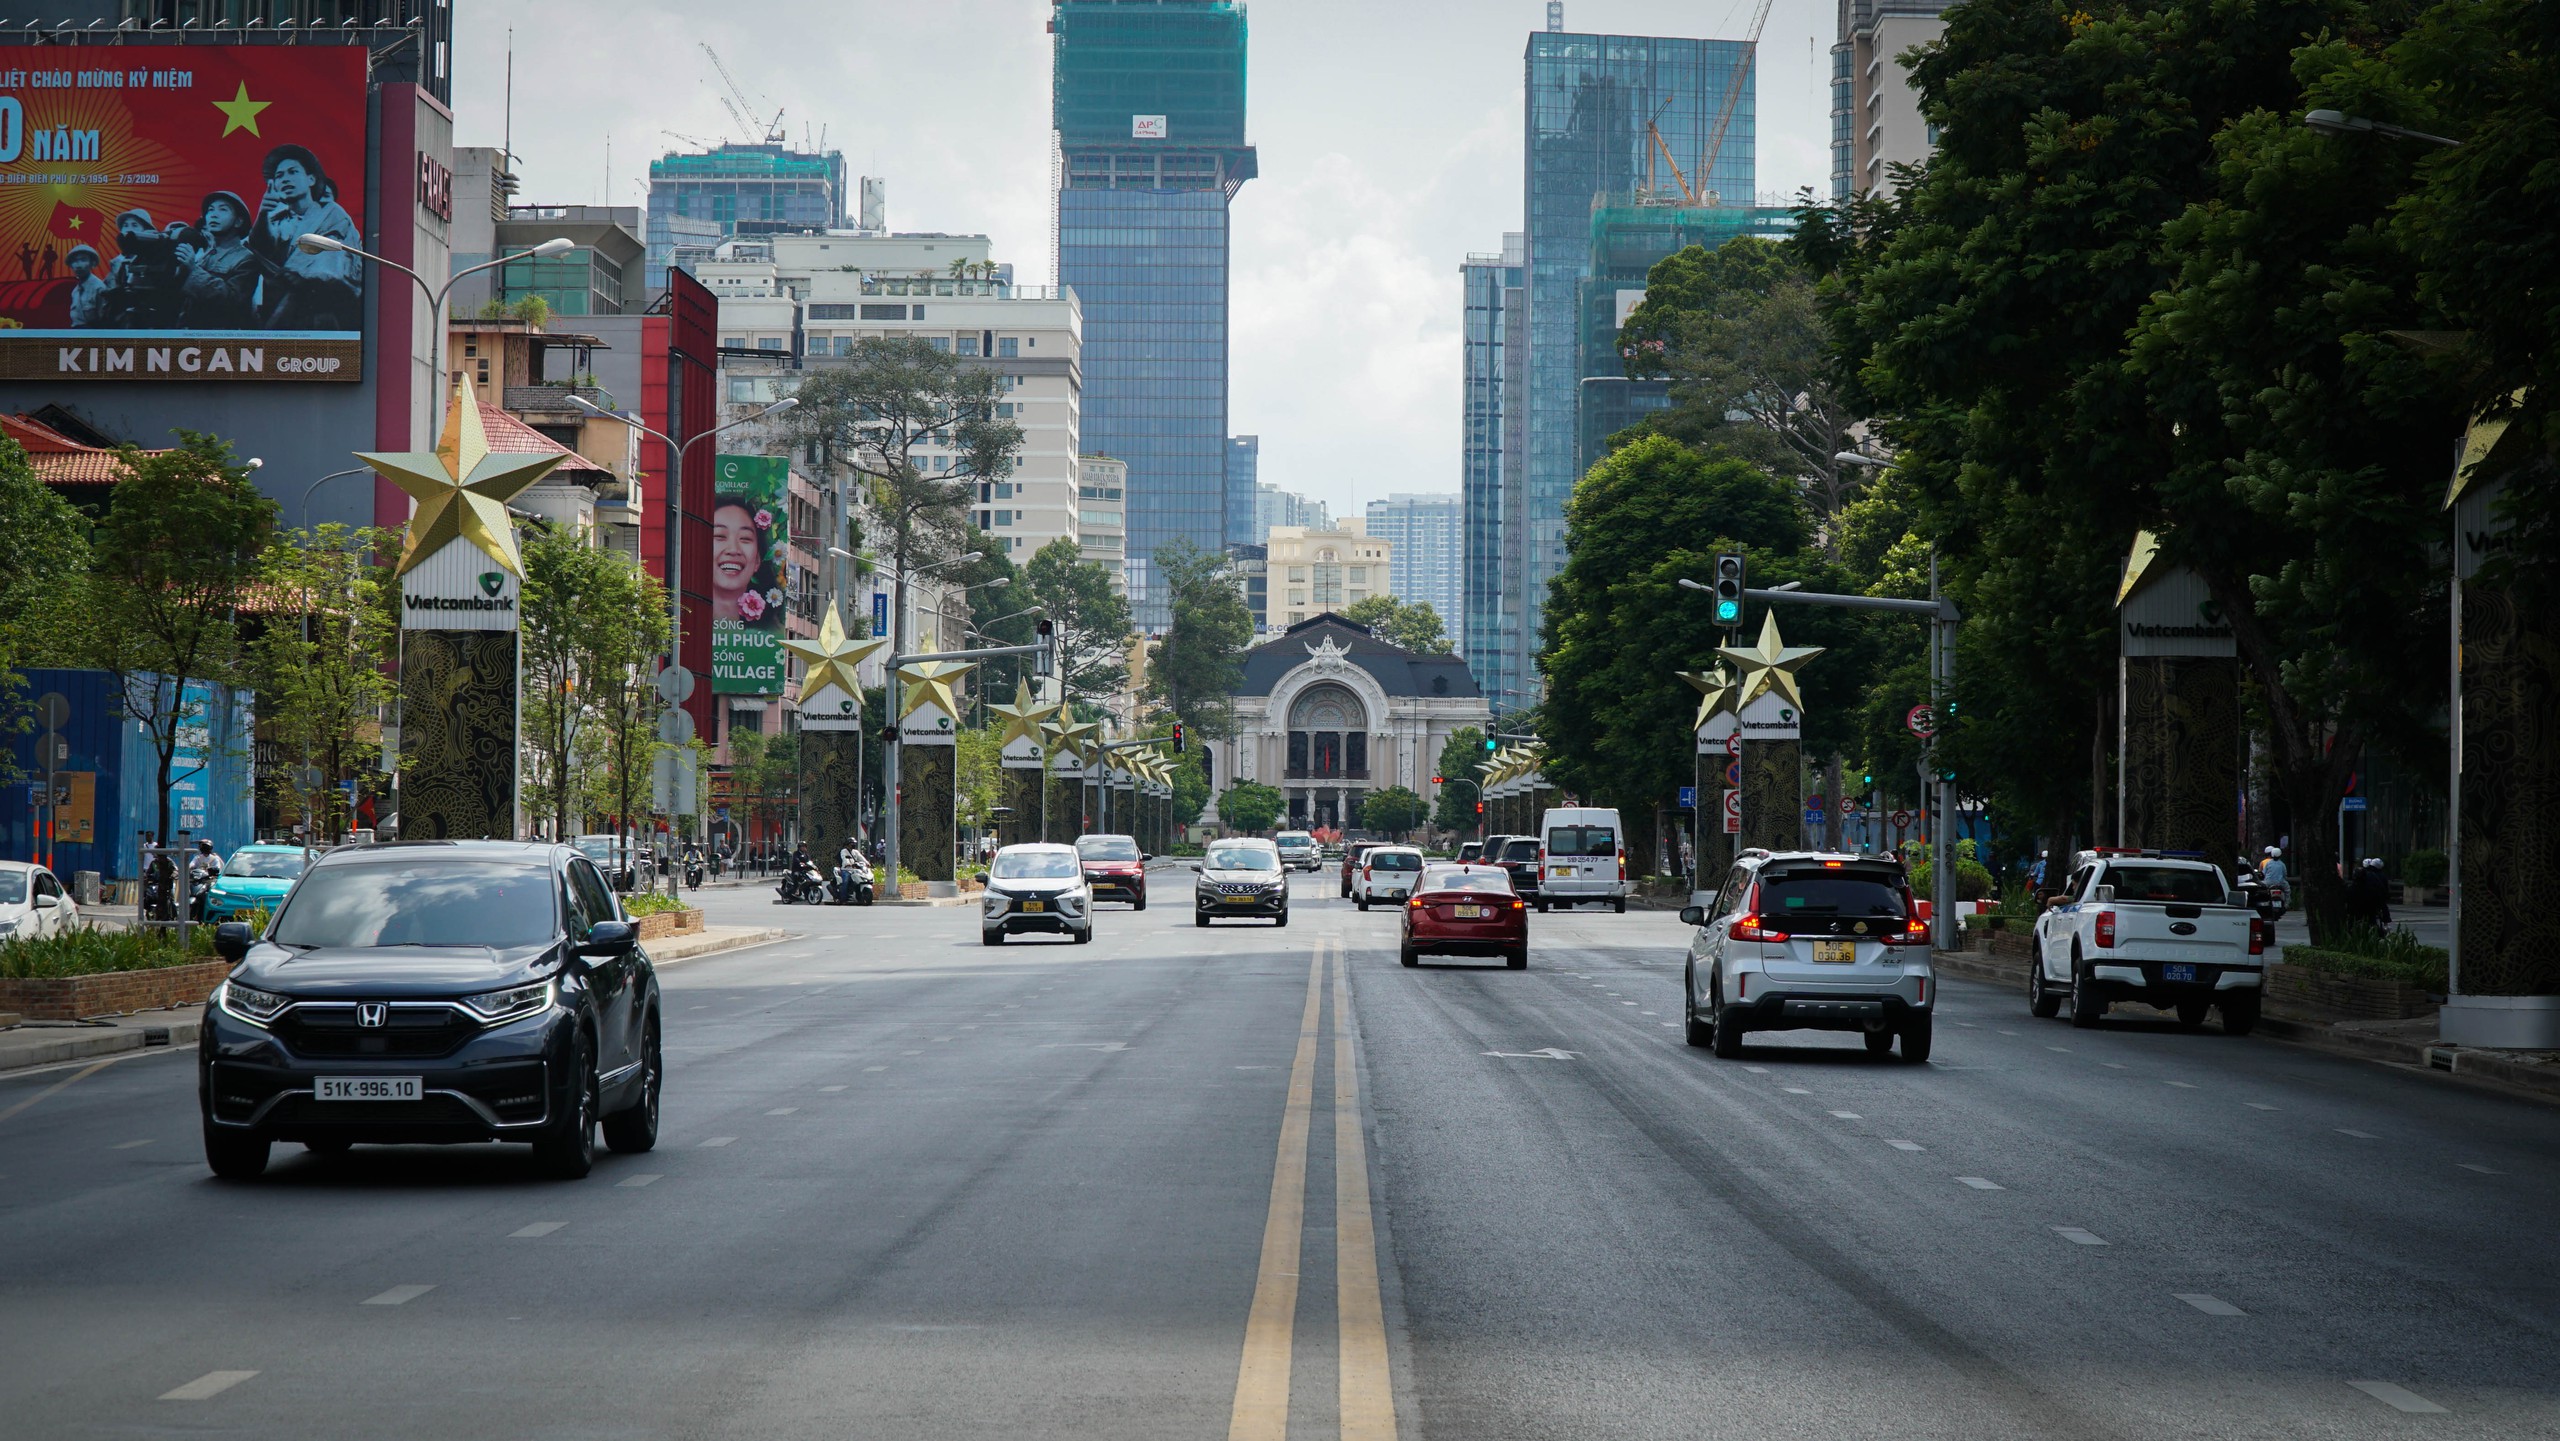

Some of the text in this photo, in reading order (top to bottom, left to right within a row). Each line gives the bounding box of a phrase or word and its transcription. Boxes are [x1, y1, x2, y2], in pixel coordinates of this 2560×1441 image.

[31, 68, 72, 88] CHÀO
[77, 68, 123, 88] MỪNG
[153, 68, 192, 91] NIỆM
[34, 124, 100, 161] NĂM
[119, 174, 159, 184] 7/5/2024)
[59, 347, 341, 373] KIM NGAN GROUP
[405, 594, 514, 611] Vietcombank
[713, 617, 745, 630] SỐNG
[2127, 622, 2234, 637] Vietcombank
[732, 631, 776, 648] PHÚC
[713, 649, 745, 662] SỐNG
[712, 665, 776, 679] VILLAGE
[803, 712, 858, 721] Vietcombank
[1742, 721, 1799, 729] Vietcombank
[904, 728, 954, 736] Vietcombank
[1699, 737, 1727, 745] Vietco
[1817, 951, 1851, 961] 030.36
[323, 1081, 414, 1097] 51K-996.10
